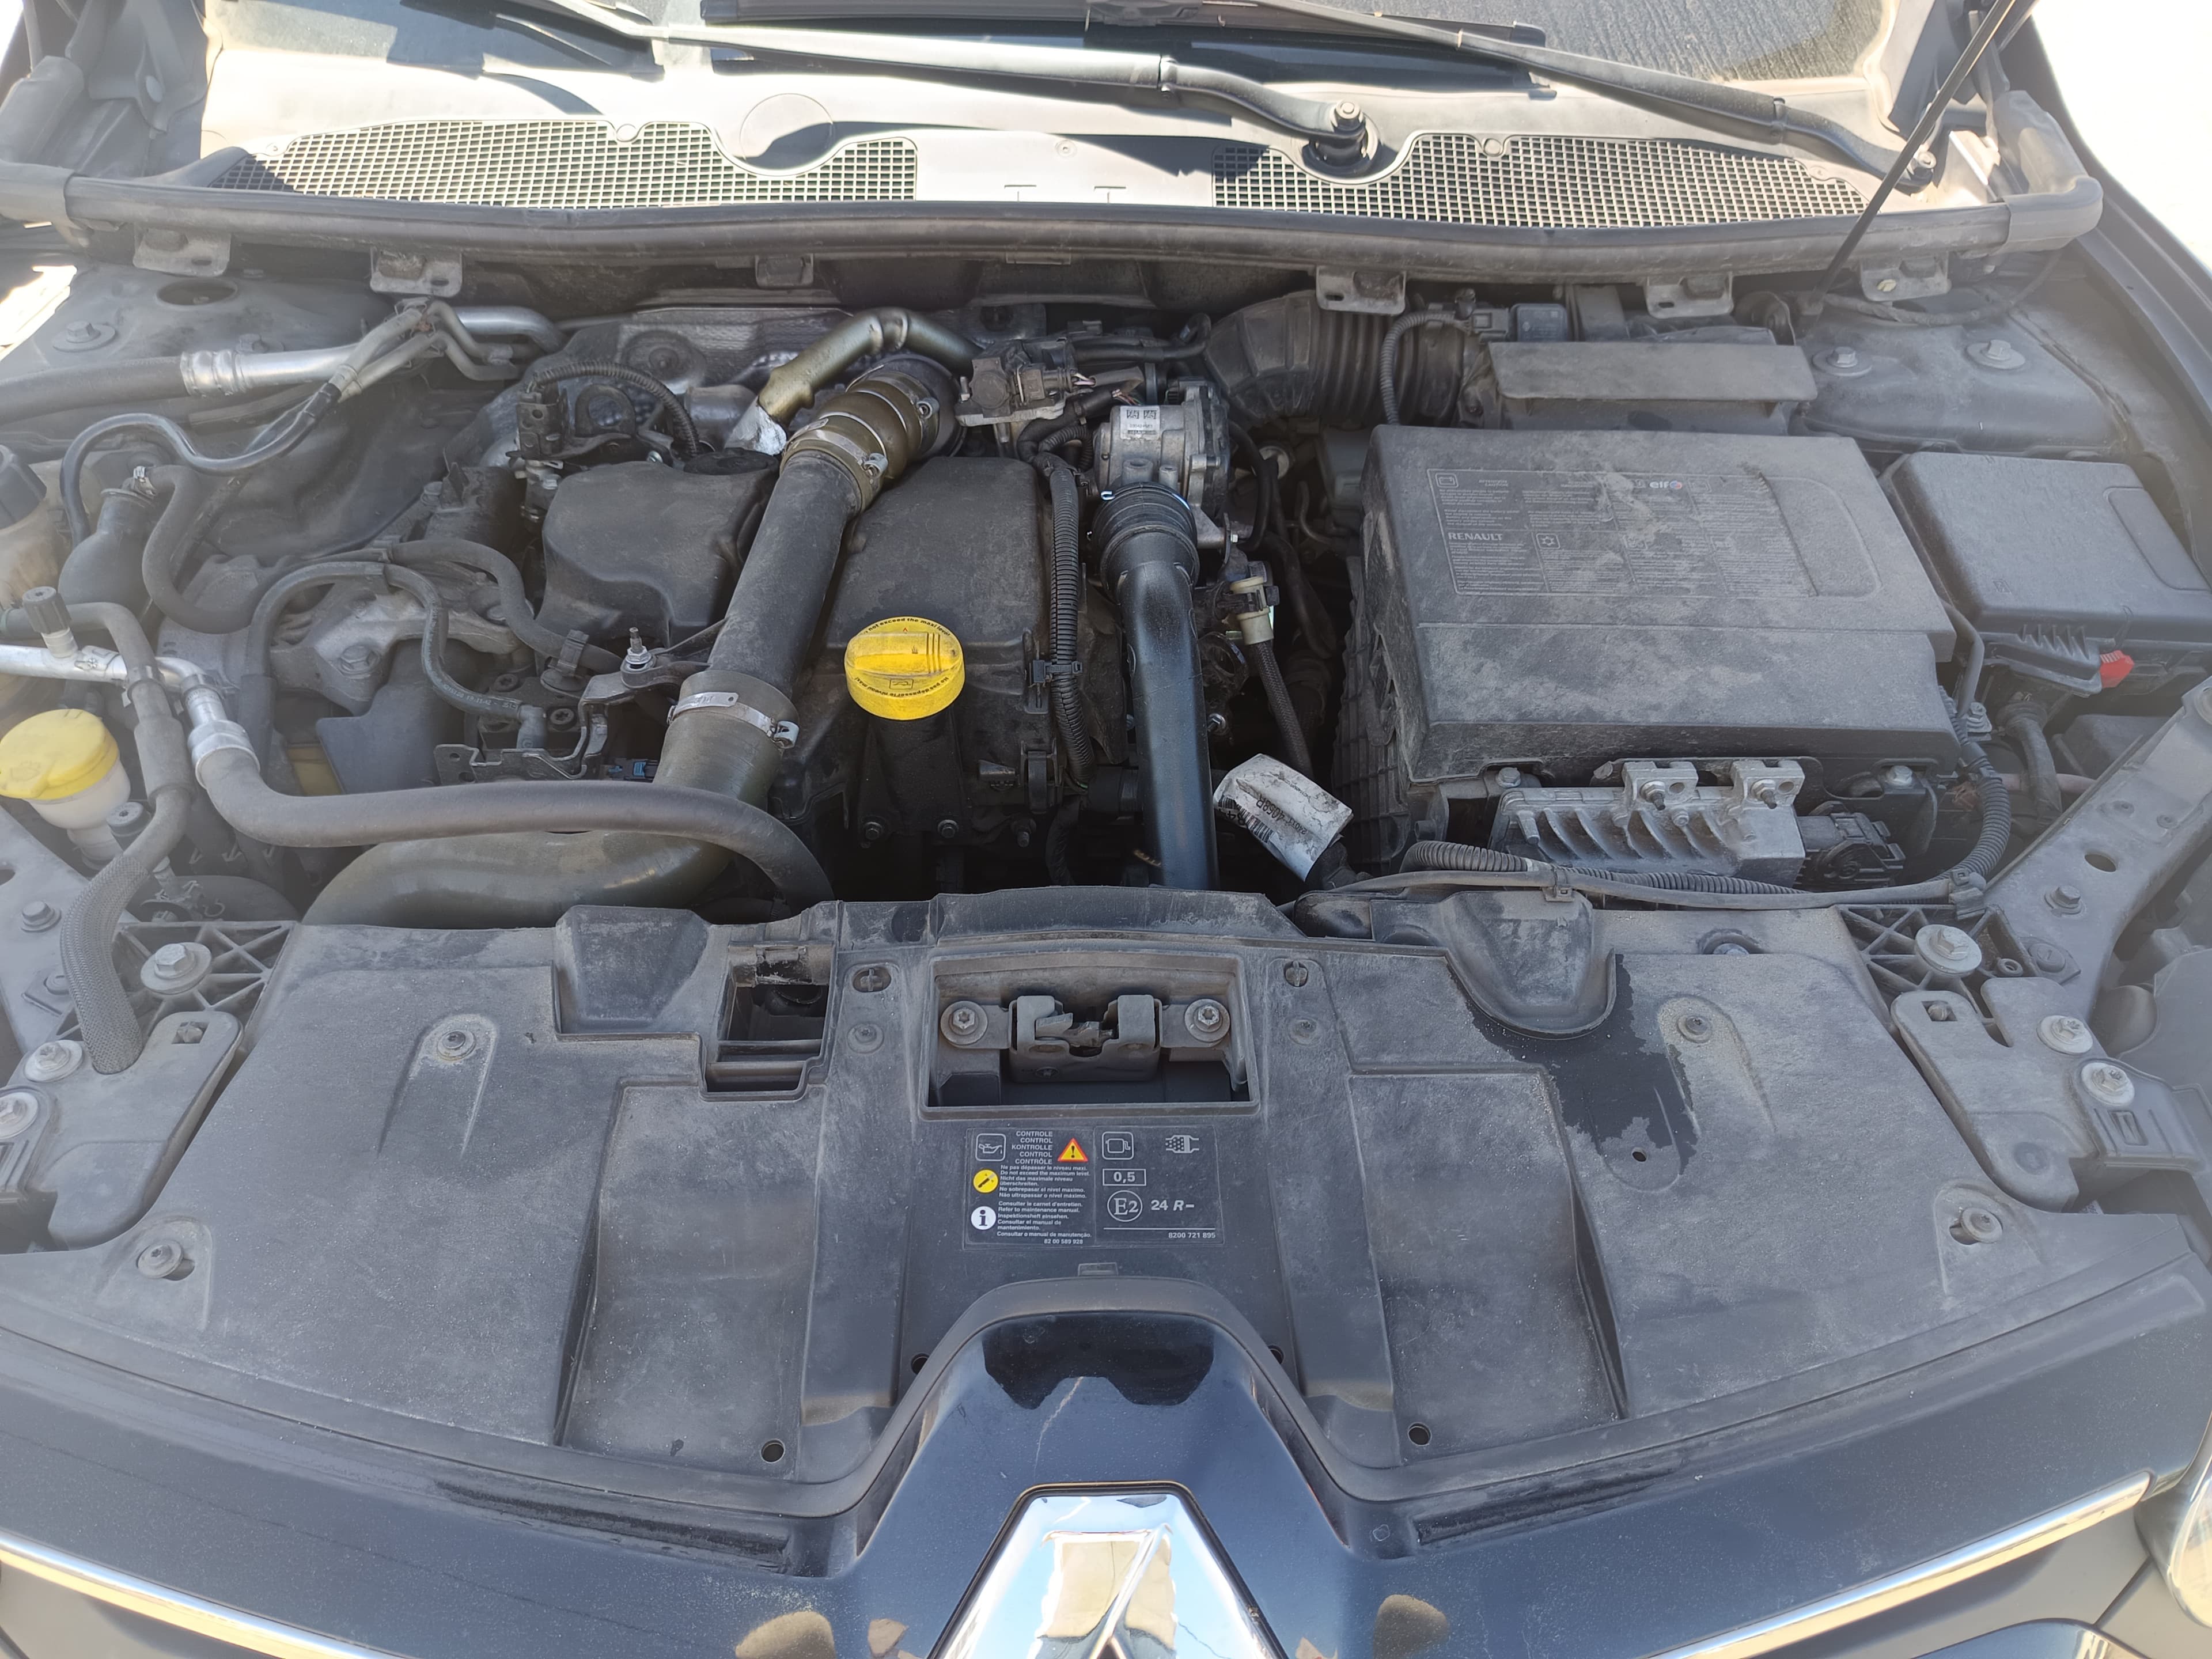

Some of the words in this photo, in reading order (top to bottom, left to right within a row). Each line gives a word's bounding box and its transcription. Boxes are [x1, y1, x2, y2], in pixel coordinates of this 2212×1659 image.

[1649, 481, 1670, 489] elf
[1448, 532, 1503, 541] RENAULT
[880, 618, 906, 626] exceed
[920, 620, 937, 628] maxi
[937, 626, 950, 636] level
[1113, 1172, 1135, 1183] 0,5
[1113, 1198, 1139, 1215] E2
[1151, 1200, 1168, 1210] 24
